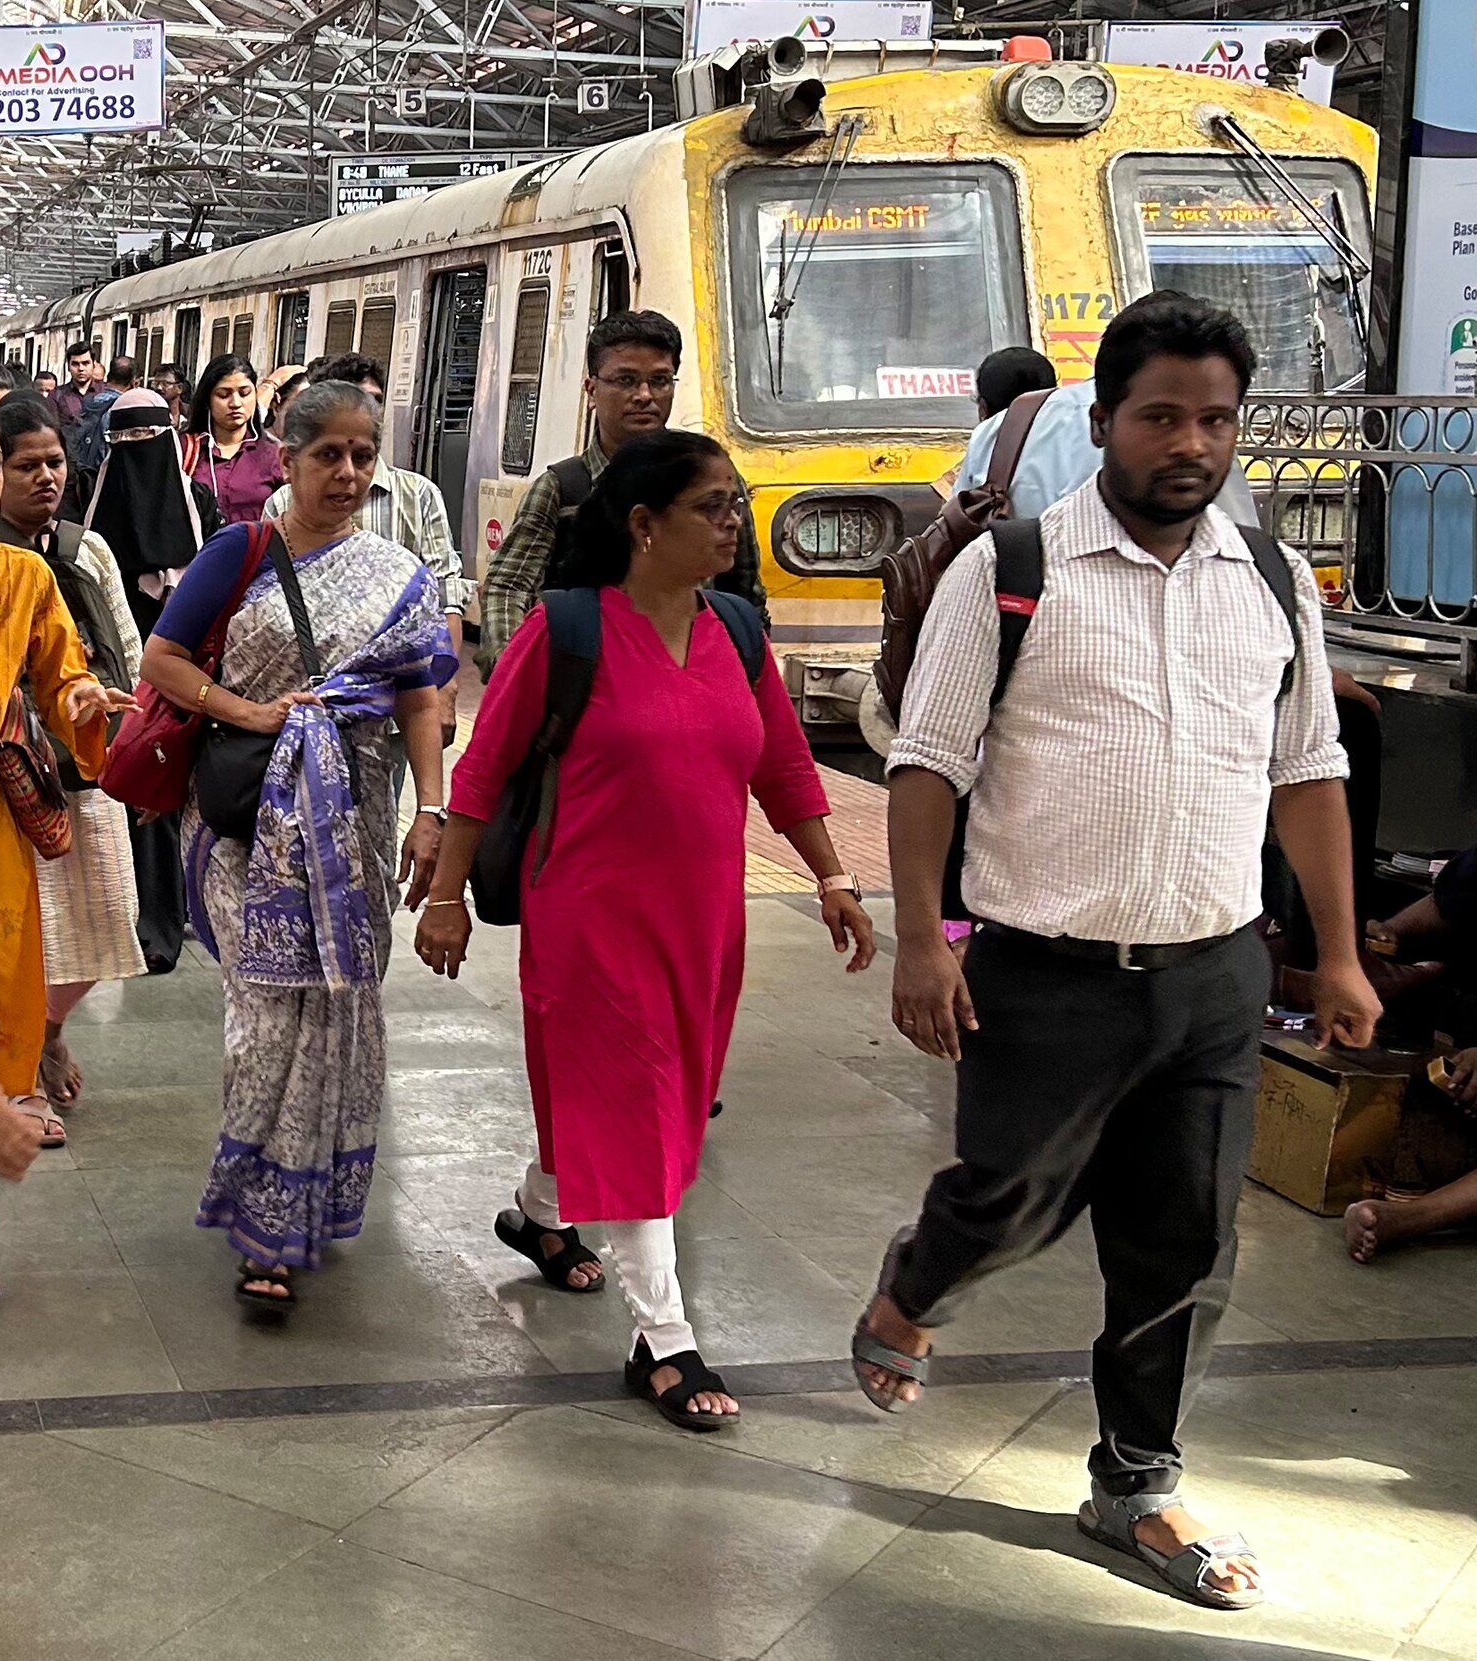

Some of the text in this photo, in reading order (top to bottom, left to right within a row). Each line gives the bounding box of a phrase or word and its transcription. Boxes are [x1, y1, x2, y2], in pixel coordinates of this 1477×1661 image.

[80, 64, 135, 82] OOH
[31, 88, 44, 96] For
[47, 86, 95, 97] Advertising
[404, 88, 422, 112] 5
[586, 85, 605, 108] 6
[50, 95, 135, 122] 74688
[378, 165, 409, 178] THANE
[459, 163, 471, 176] 12
[472, 163, 499, 175] Fast
[867, 205, 929, 230] CSMT
[1453, 222, 1477, 237] Base
[1452, 240, 1475, 256] Plan
[1043, 292, 1114, 320] 1172
[881, 373, 974, 396] THANE
